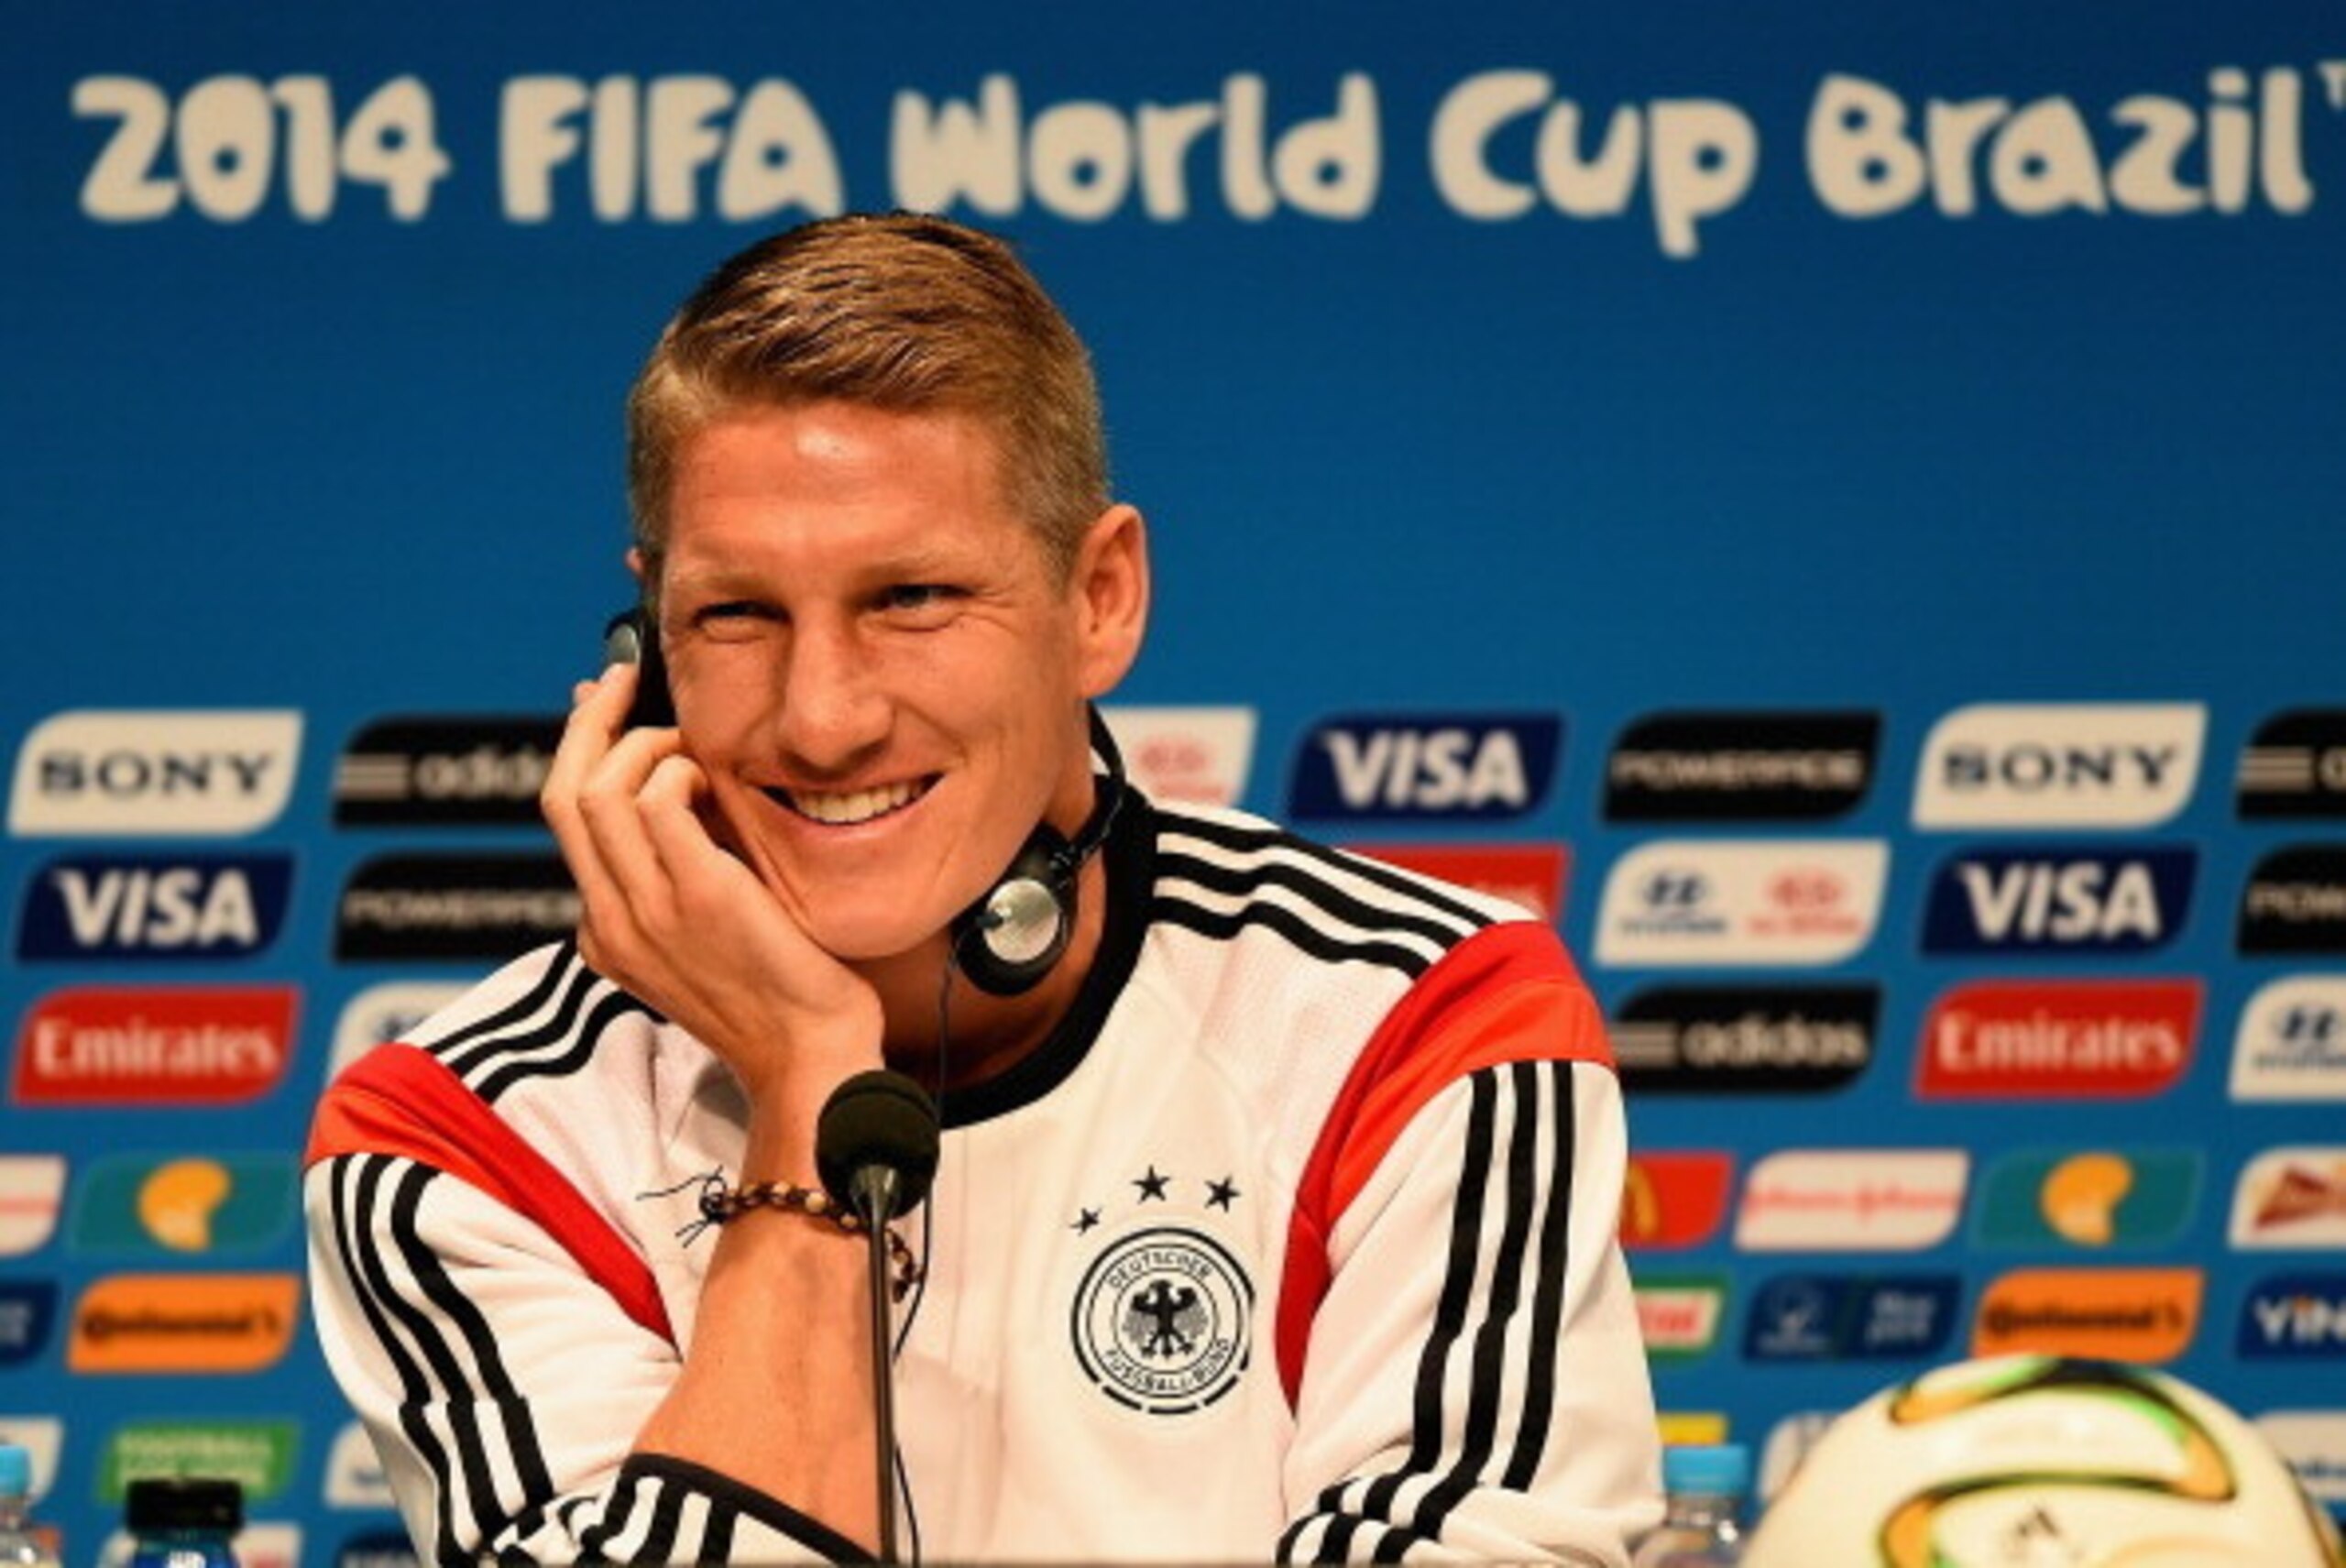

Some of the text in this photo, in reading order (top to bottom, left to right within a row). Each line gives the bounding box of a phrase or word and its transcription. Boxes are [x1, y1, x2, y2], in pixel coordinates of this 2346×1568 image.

[71, 75, 451, 224] 2014
[499, 74, 846, 224] FIFA
[890, 72, 1380, 222] World
[1430, 68, 1758, 259] Cup
[38, 751, 272, 799] SONY
[1320, 729, 1529, 808] VISA
[1941, 745, 2176, 791] SONY
[53, 867, 261, 948] VISA
[1956, 860, 2163, 941] VISA
[31, 1012, 280, 1081] Emirates
[1679, 1013, 1868, 1067] adidas
[1935, 1009, 2187, 1074] Emirates
